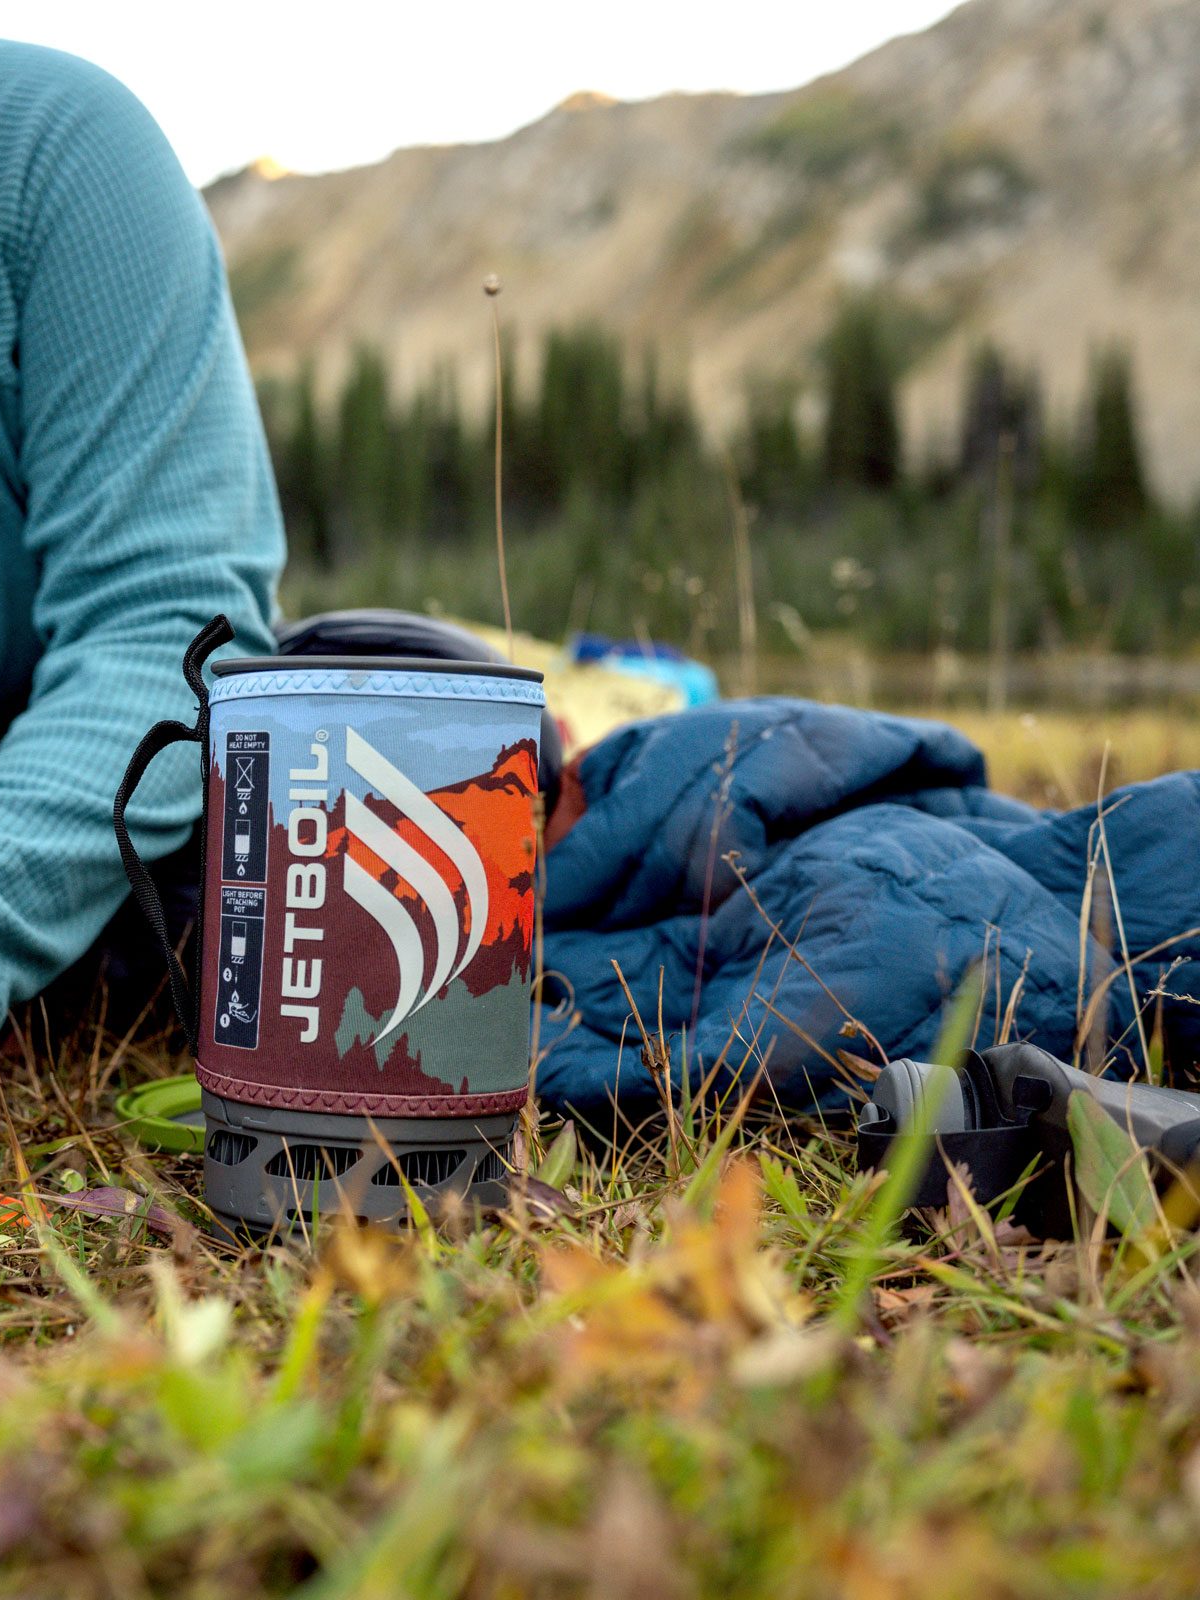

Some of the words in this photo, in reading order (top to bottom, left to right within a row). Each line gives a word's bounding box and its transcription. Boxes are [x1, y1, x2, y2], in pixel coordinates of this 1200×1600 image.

[229, 741, 243, 749] HEAT
[243, 741, 265, 749] EMPTY
[223, 890, 237, 898] LIGHT
[237, 891, 263, 900] BEFORE
[226, 898, 258, 907] ATTACHING
[233, 905, 246, 914] POT
